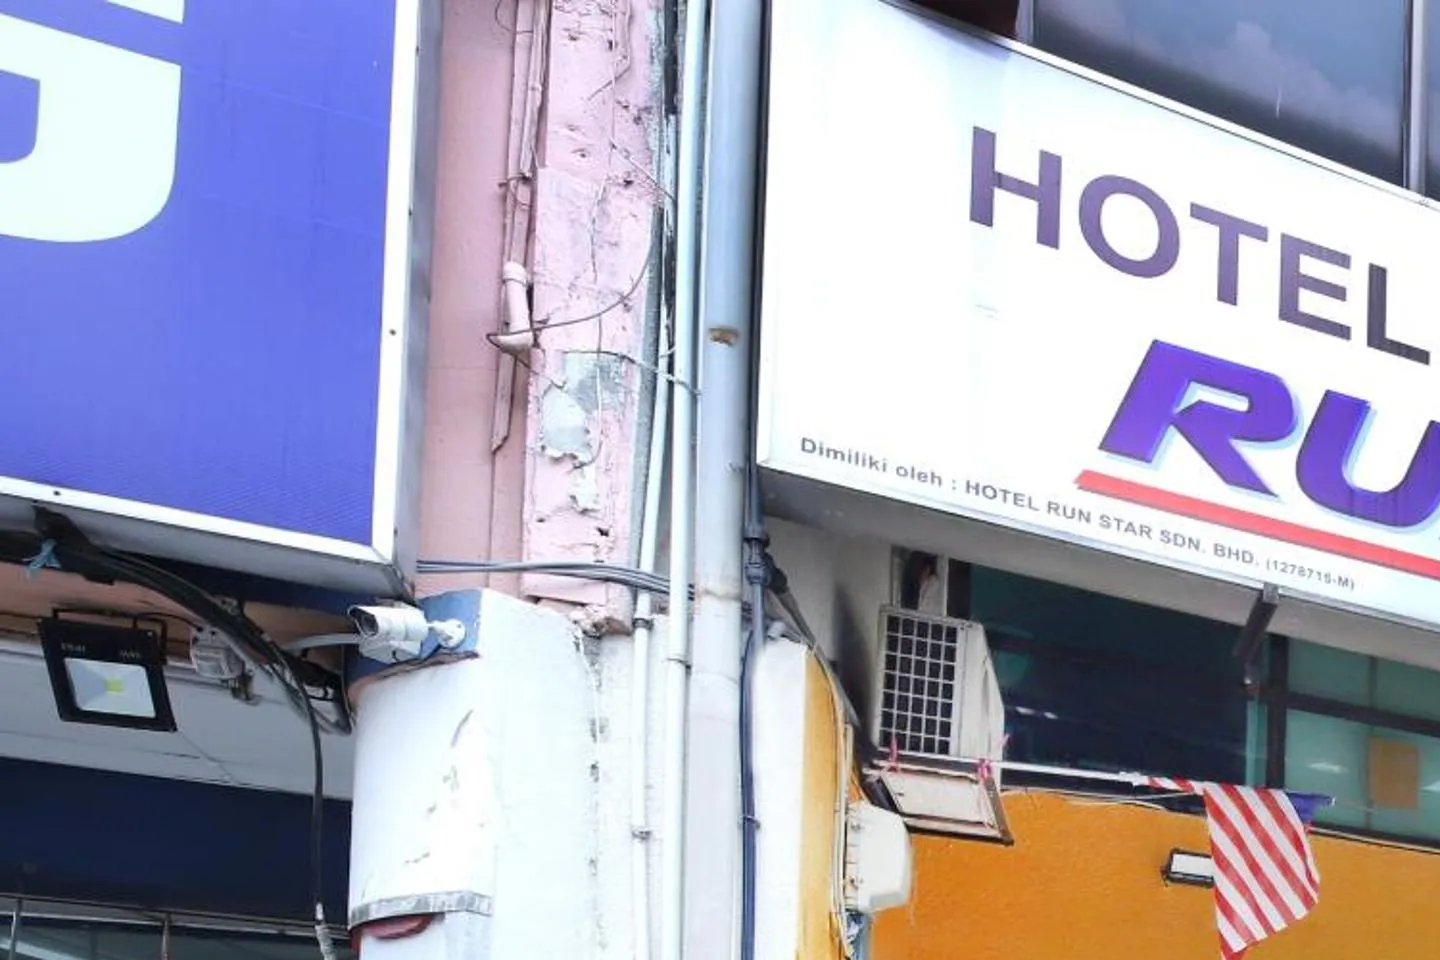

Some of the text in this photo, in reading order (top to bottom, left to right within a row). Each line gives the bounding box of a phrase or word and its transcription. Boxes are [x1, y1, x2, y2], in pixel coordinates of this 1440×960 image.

[970, 124, 1431, 366] HOTEL
[800, 436, 888, 473] Dimiliki
[895, 465, 943, 488] oleh
[965, 479, 1040, 512] HOTEL
[1047, 499, 1093, 525] RUN
[1099, 514, 1153, 541] STAR
[1159, 529, 1207, 554] SDN.
[1213, 543, 1260, 566] BHD.
